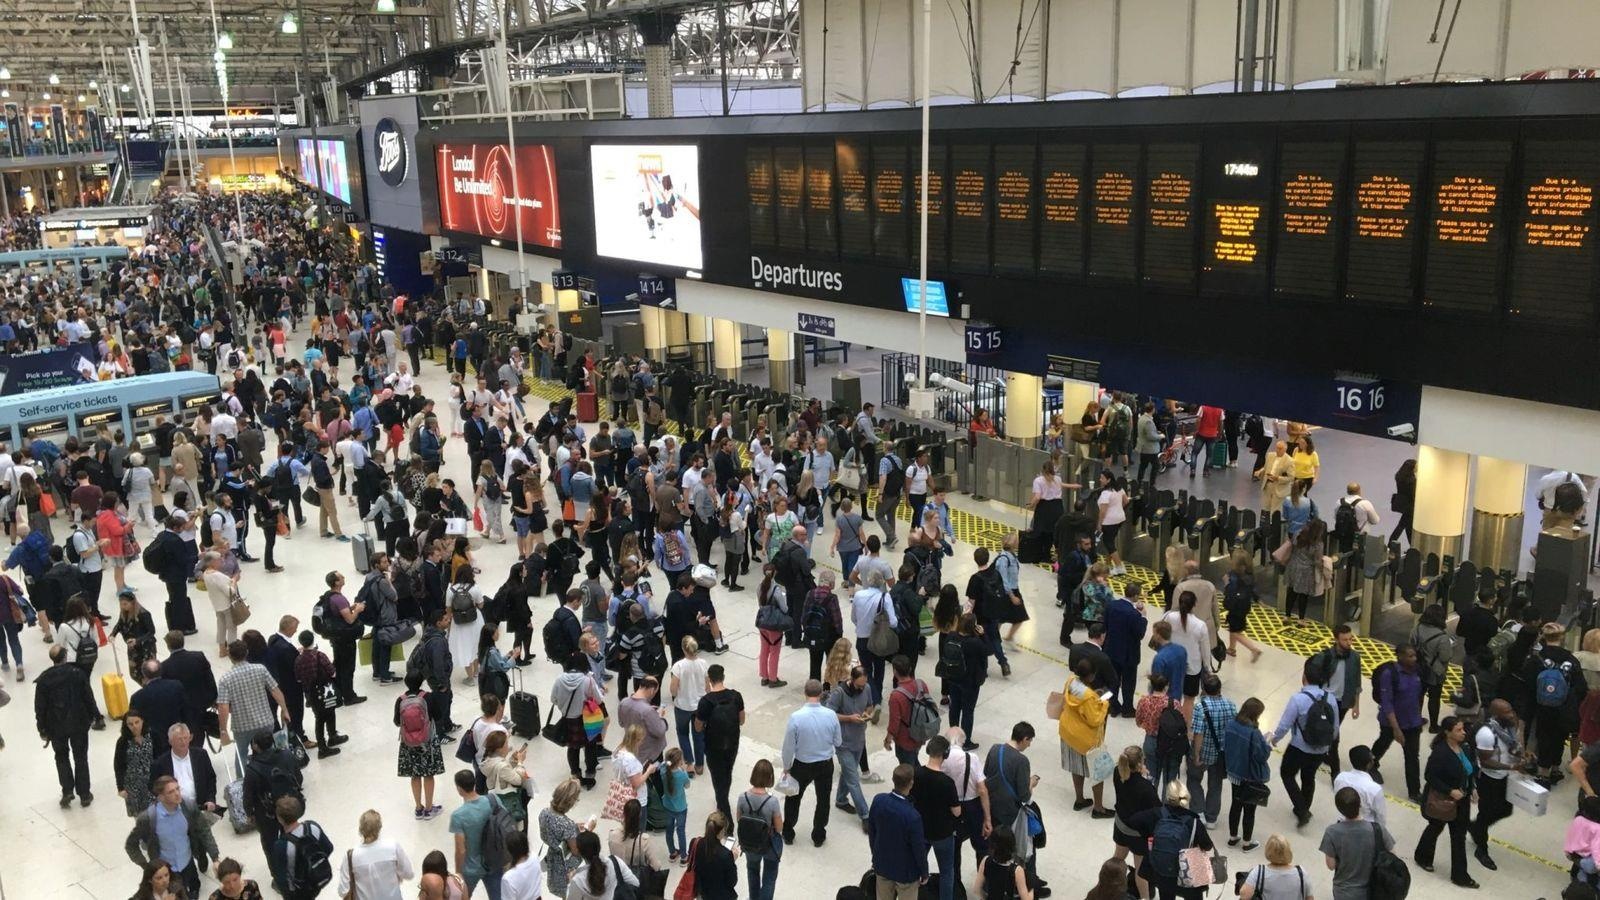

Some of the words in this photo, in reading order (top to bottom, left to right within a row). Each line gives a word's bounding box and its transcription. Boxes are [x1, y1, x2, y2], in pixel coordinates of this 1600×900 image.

[379, 131, 400, 172] Boots
[446, 250, 456, 259] 12
[561, 276, 573, 286] 13
[751, 256, 842, 290] Departures
[640, 281, 648, 294] 14
[650, 280, 664, 294] 14
[967, 331, 981, 349] 15
[986, 331, 1001, 349] 15
[19, 400, 81, 418] Self-service
[84, 395, 118, 408] tickets
[1337, 386, 1362, 411] 16
[1369, 386, 1384, 411] 16
